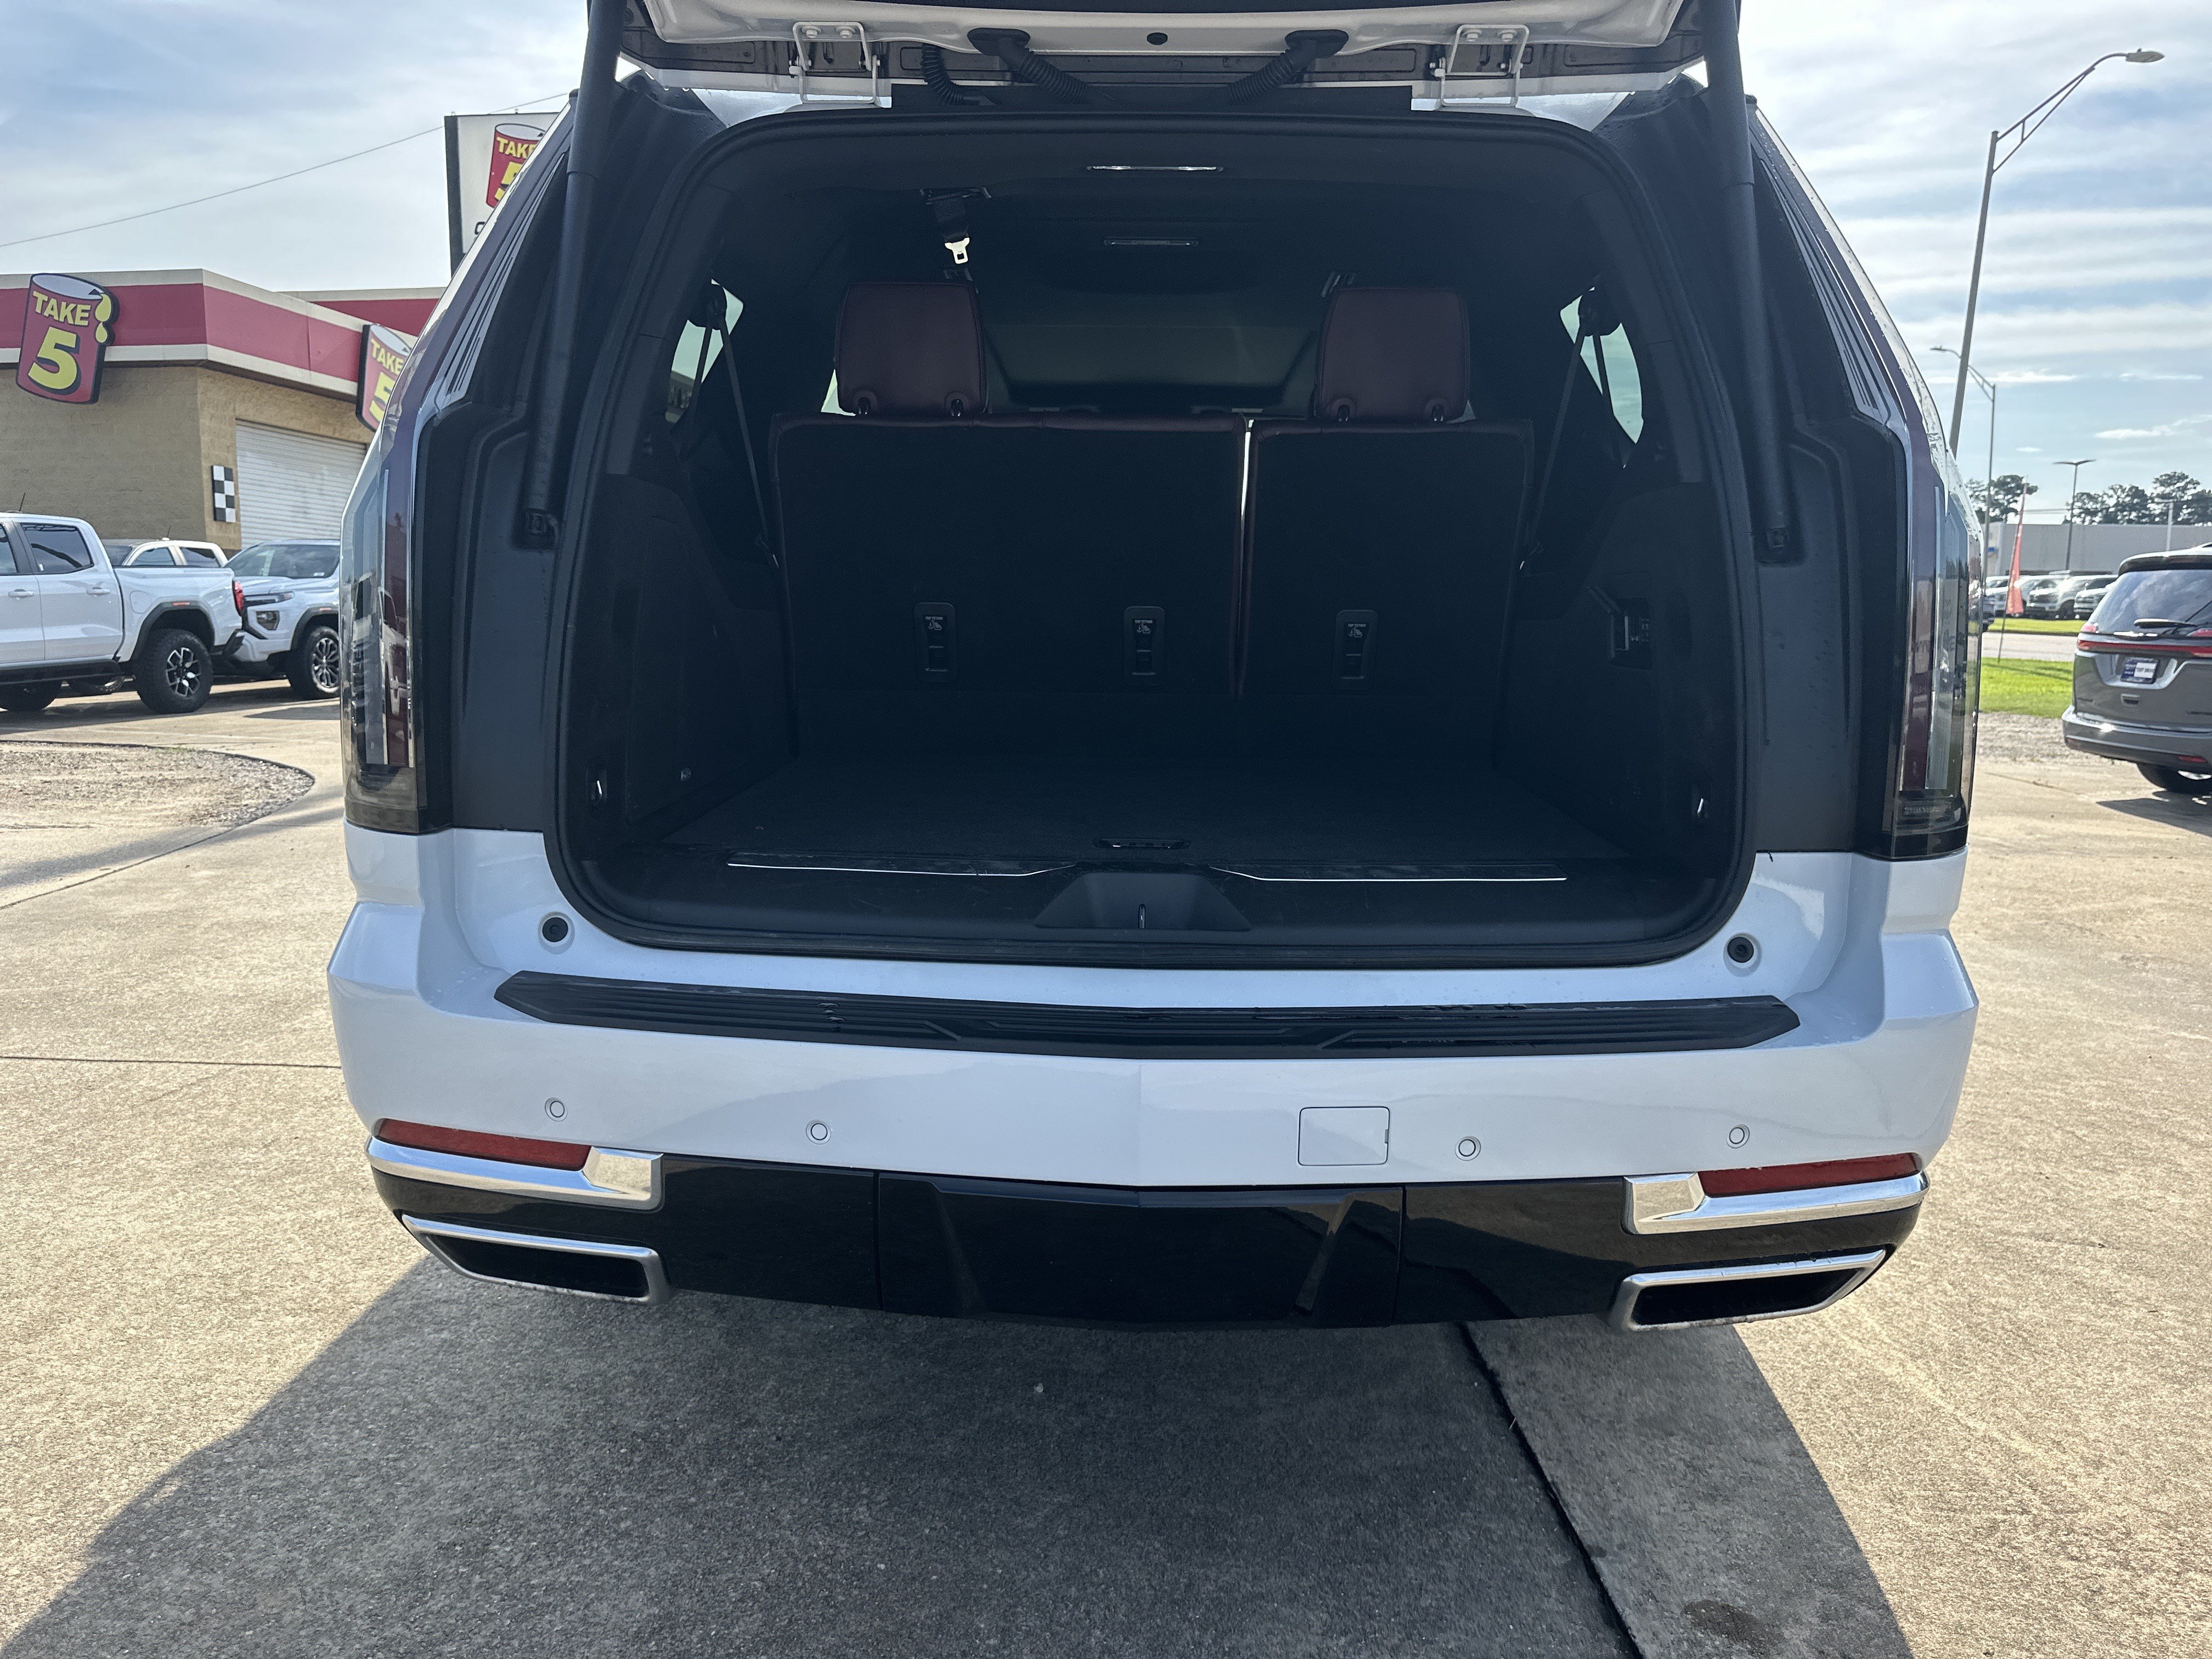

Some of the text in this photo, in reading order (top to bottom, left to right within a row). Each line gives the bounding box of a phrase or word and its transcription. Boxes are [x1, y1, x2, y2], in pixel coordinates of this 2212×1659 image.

[32, 291, 91, 326] TAKE
[28, 326, 77, 390] 5
[371, 338, 404, 375] TAKE
